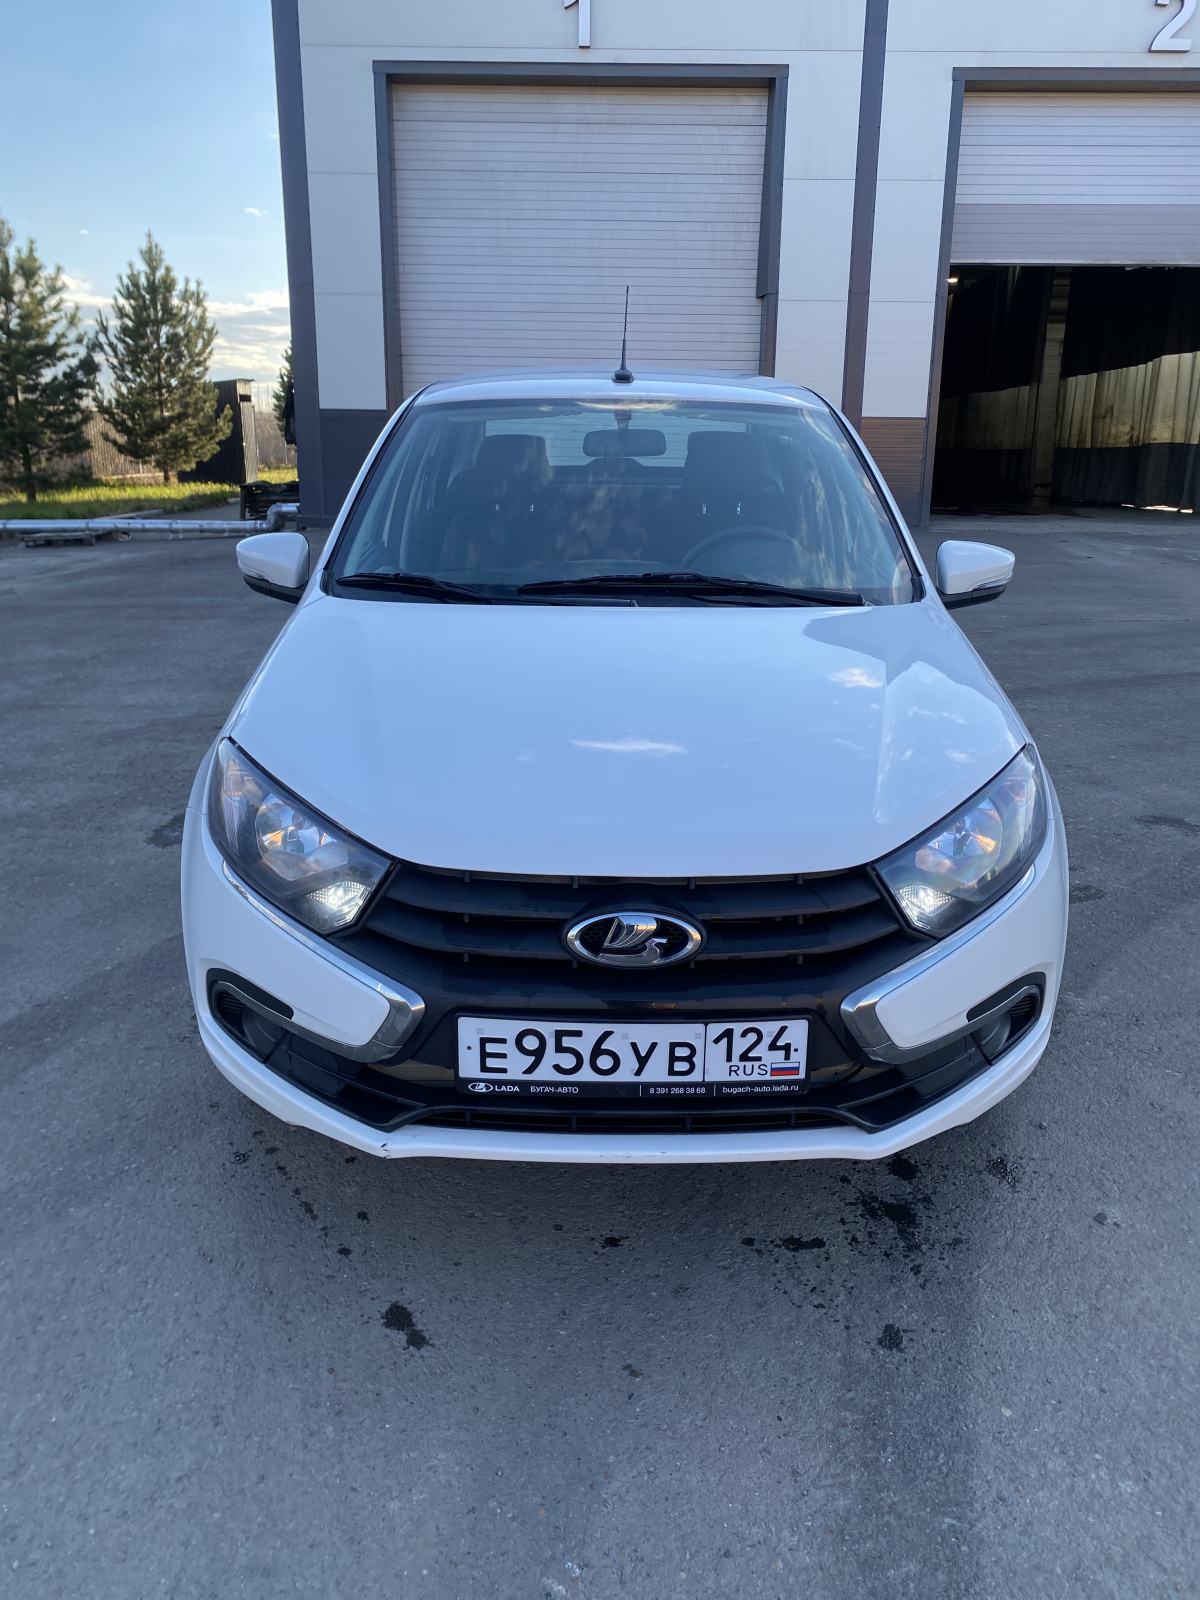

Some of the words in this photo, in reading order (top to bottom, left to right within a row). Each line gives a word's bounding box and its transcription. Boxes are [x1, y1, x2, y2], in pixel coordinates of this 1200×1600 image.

[563, 0, 591, 49] 1
[1148, 0, 1197, 53] 2
[479, 1027, 698, 1077] Е956УВ
[712, 1025, 792, 1063] 124
[728, 1063, 769, 1077] RUS
[530, 1085, 579, 1094] БУГАЧ-АВТО
[722, 1084, 799, 1095] bugach-auto.lada.ru
